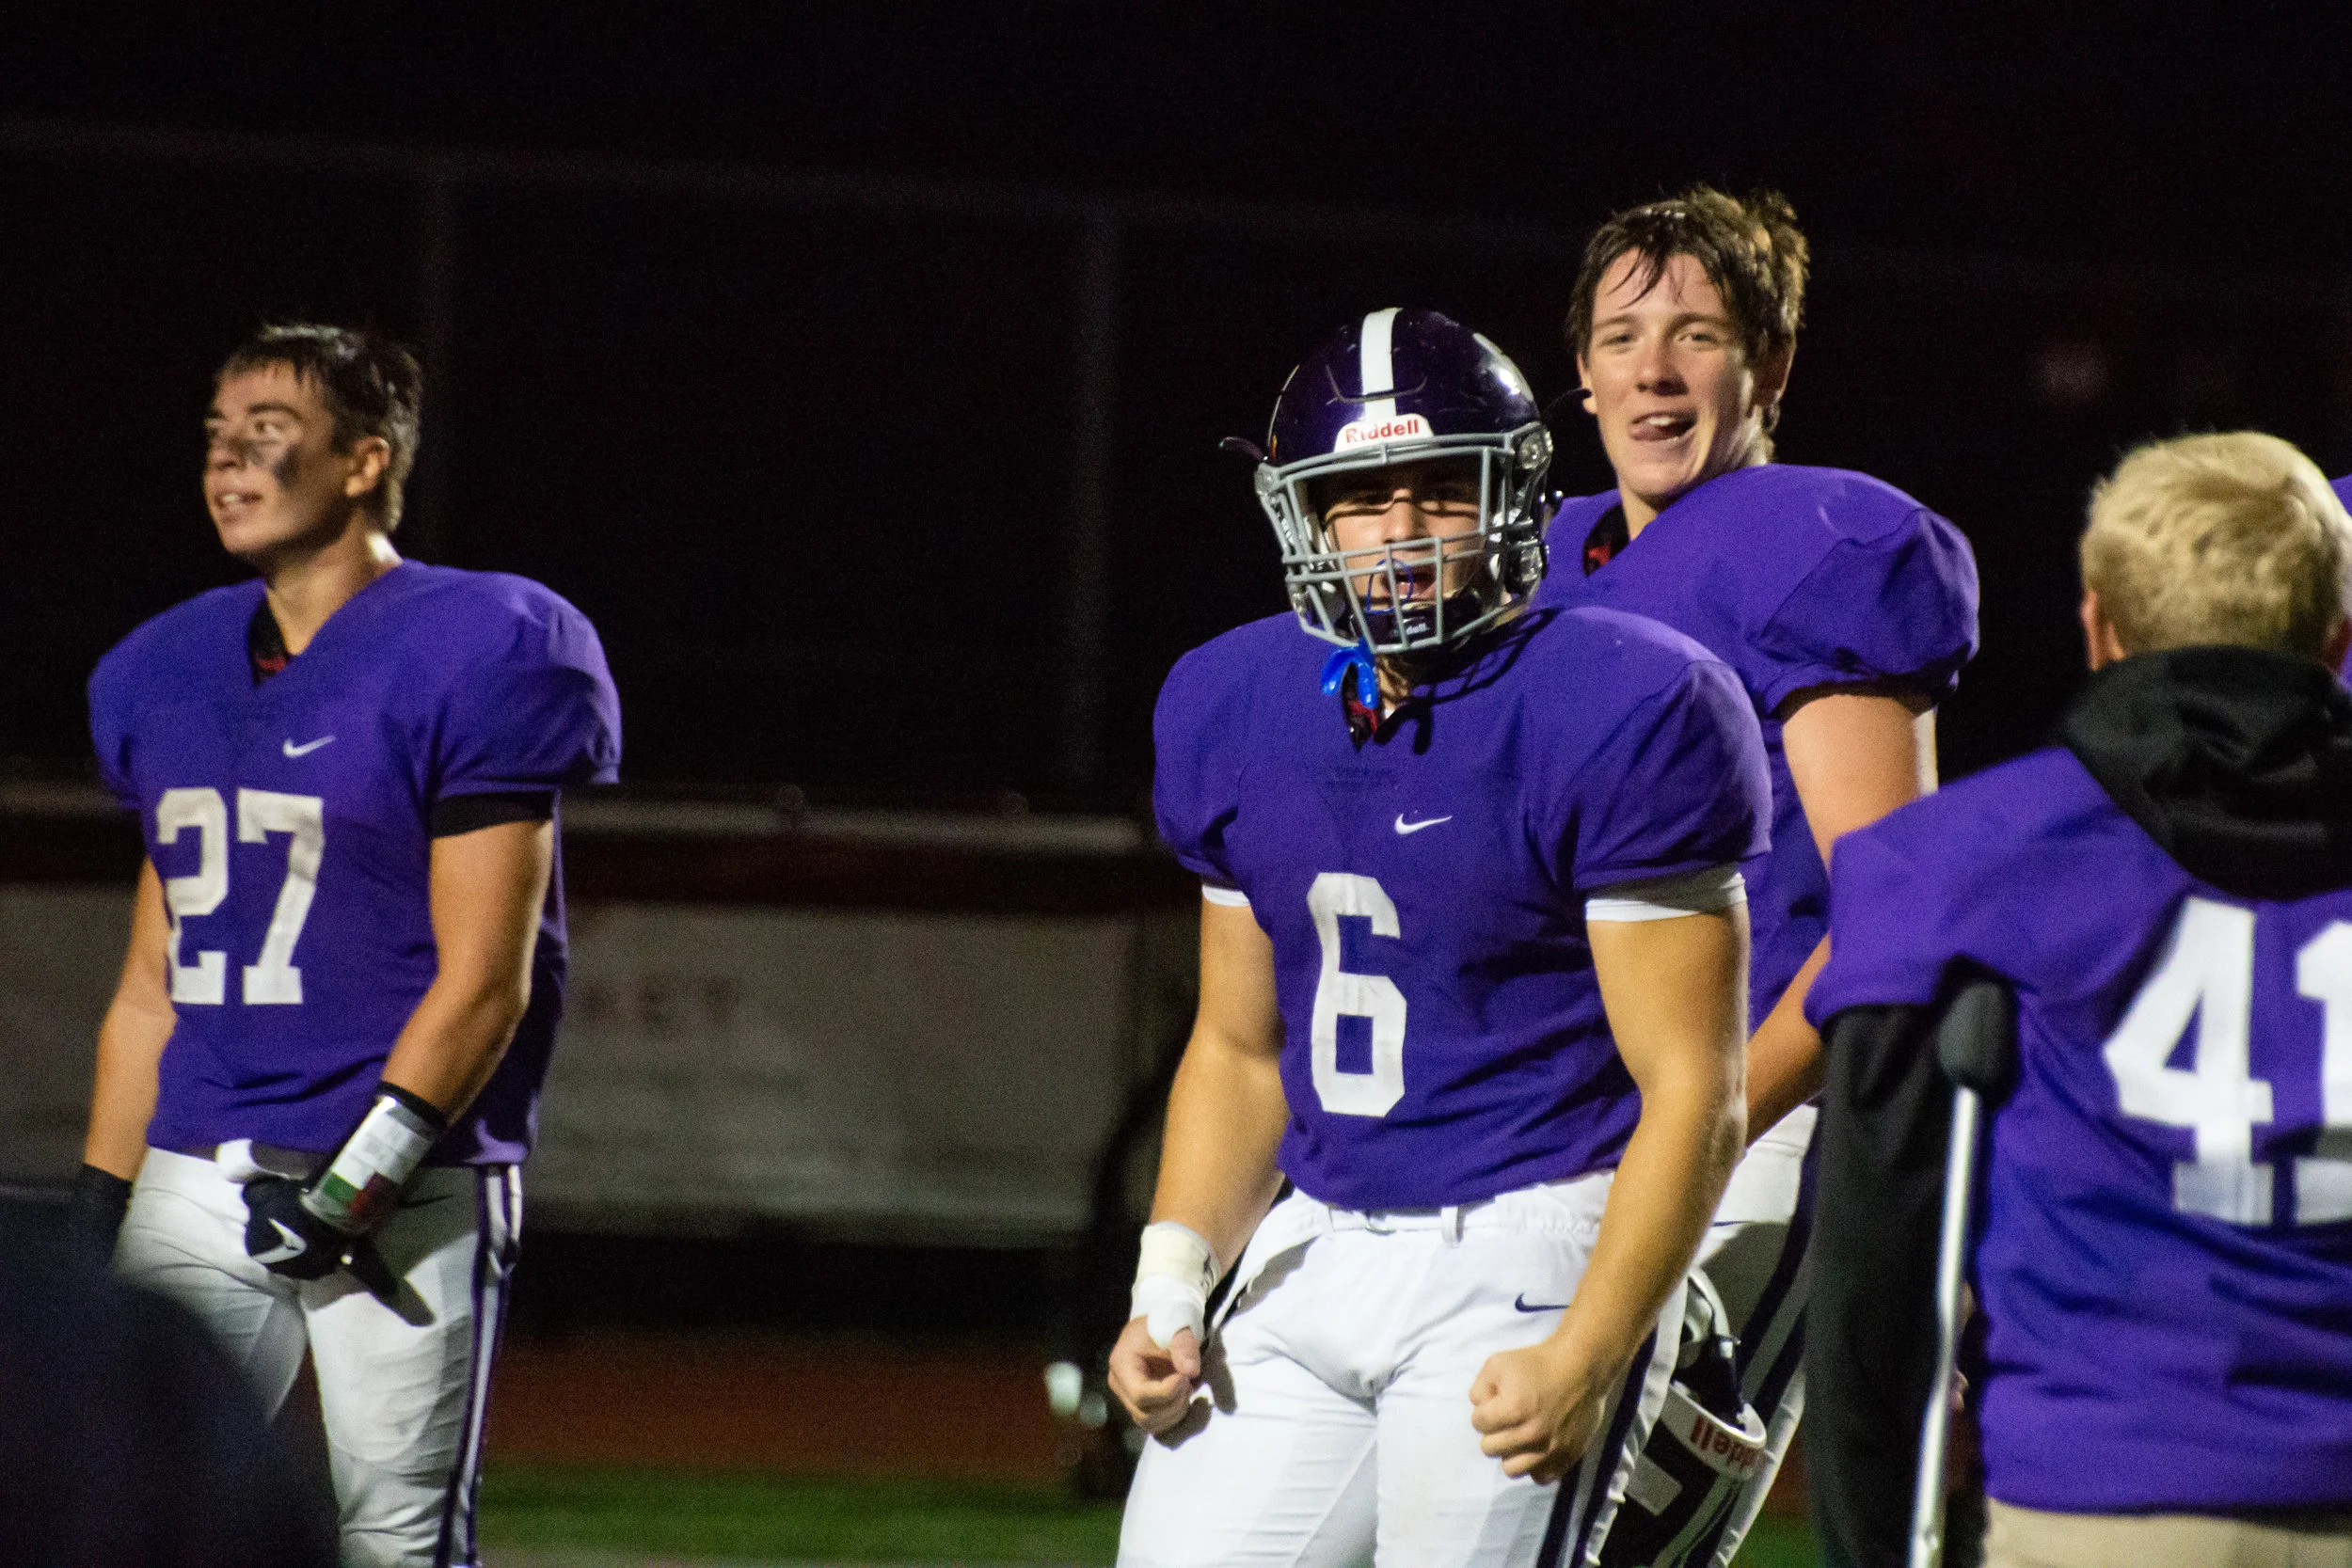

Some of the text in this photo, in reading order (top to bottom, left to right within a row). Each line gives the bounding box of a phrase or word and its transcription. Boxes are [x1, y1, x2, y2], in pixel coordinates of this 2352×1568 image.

[1345, 419, 1420, 443] Riddell
[156, 786, 326, 1005] 27
[1307, 872, 1407, 1117] 6
[2102, 896, 2352, 1225] 41
